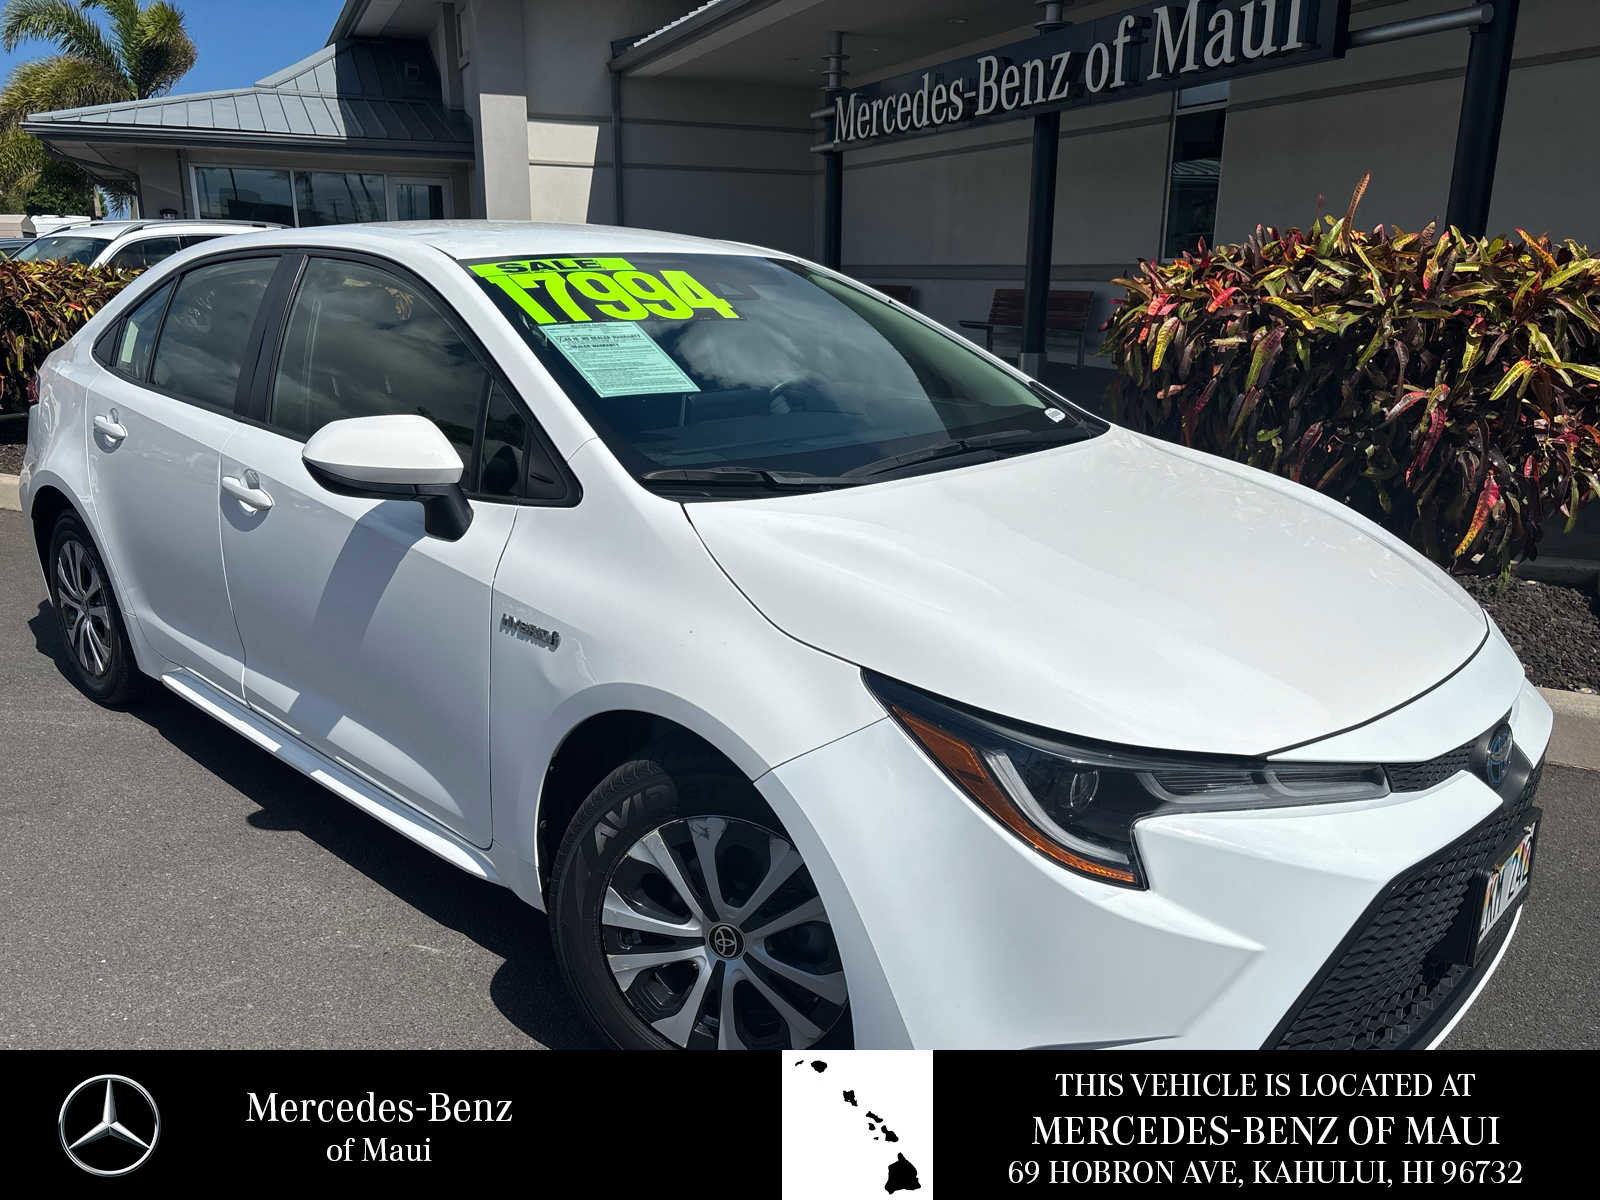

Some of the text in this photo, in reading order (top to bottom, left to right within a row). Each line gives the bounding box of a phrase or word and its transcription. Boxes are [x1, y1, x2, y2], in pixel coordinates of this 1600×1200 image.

[833, 0, 1303, 144] Mercedes-Benz of Maui
[496, 259, 602, 273] SALE
[484, 270, 740, 324] 17994
[499, 613, 560, 652] HYBRID
